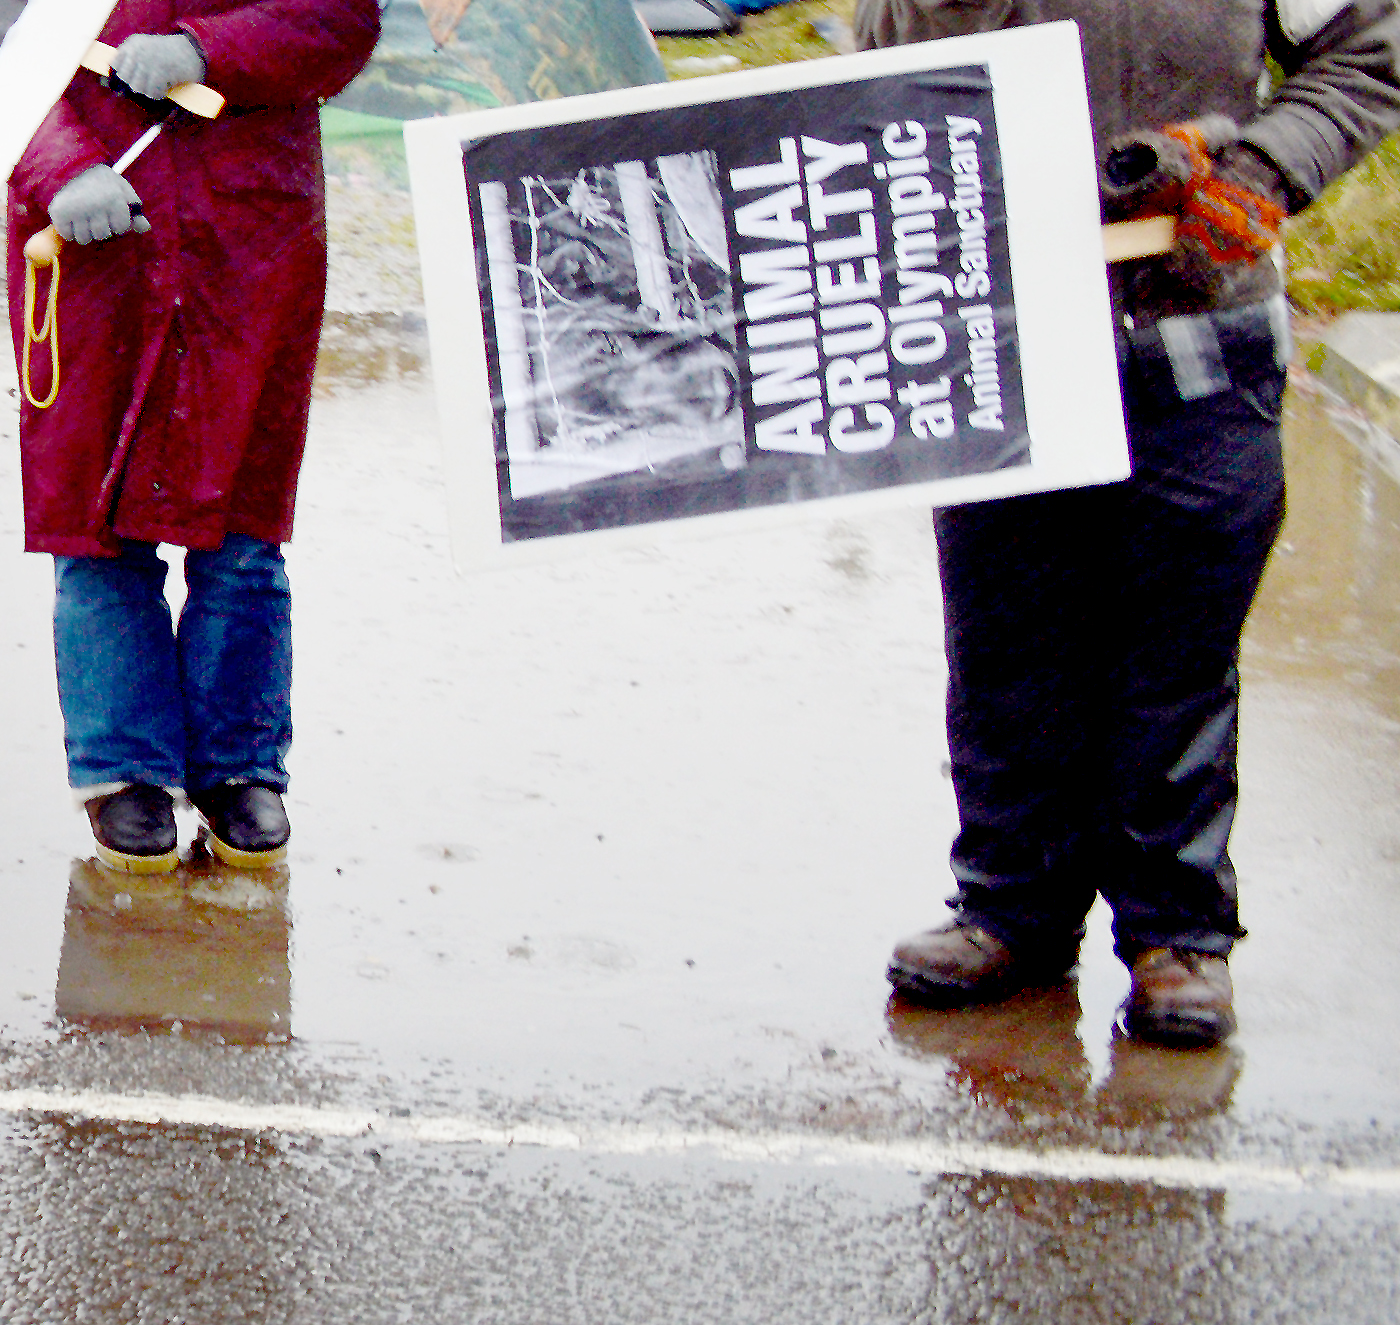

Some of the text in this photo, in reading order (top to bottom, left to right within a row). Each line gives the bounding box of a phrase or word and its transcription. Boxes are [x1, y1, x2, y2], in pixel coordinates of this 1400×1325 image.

[728, 134, 829, 460] ANIMAL
[799, 133, 897, 457] CRUELTY
[872, 119, 957, 443] at Olympic
[944, 113, 1006, 434] Animal Sanctuary
